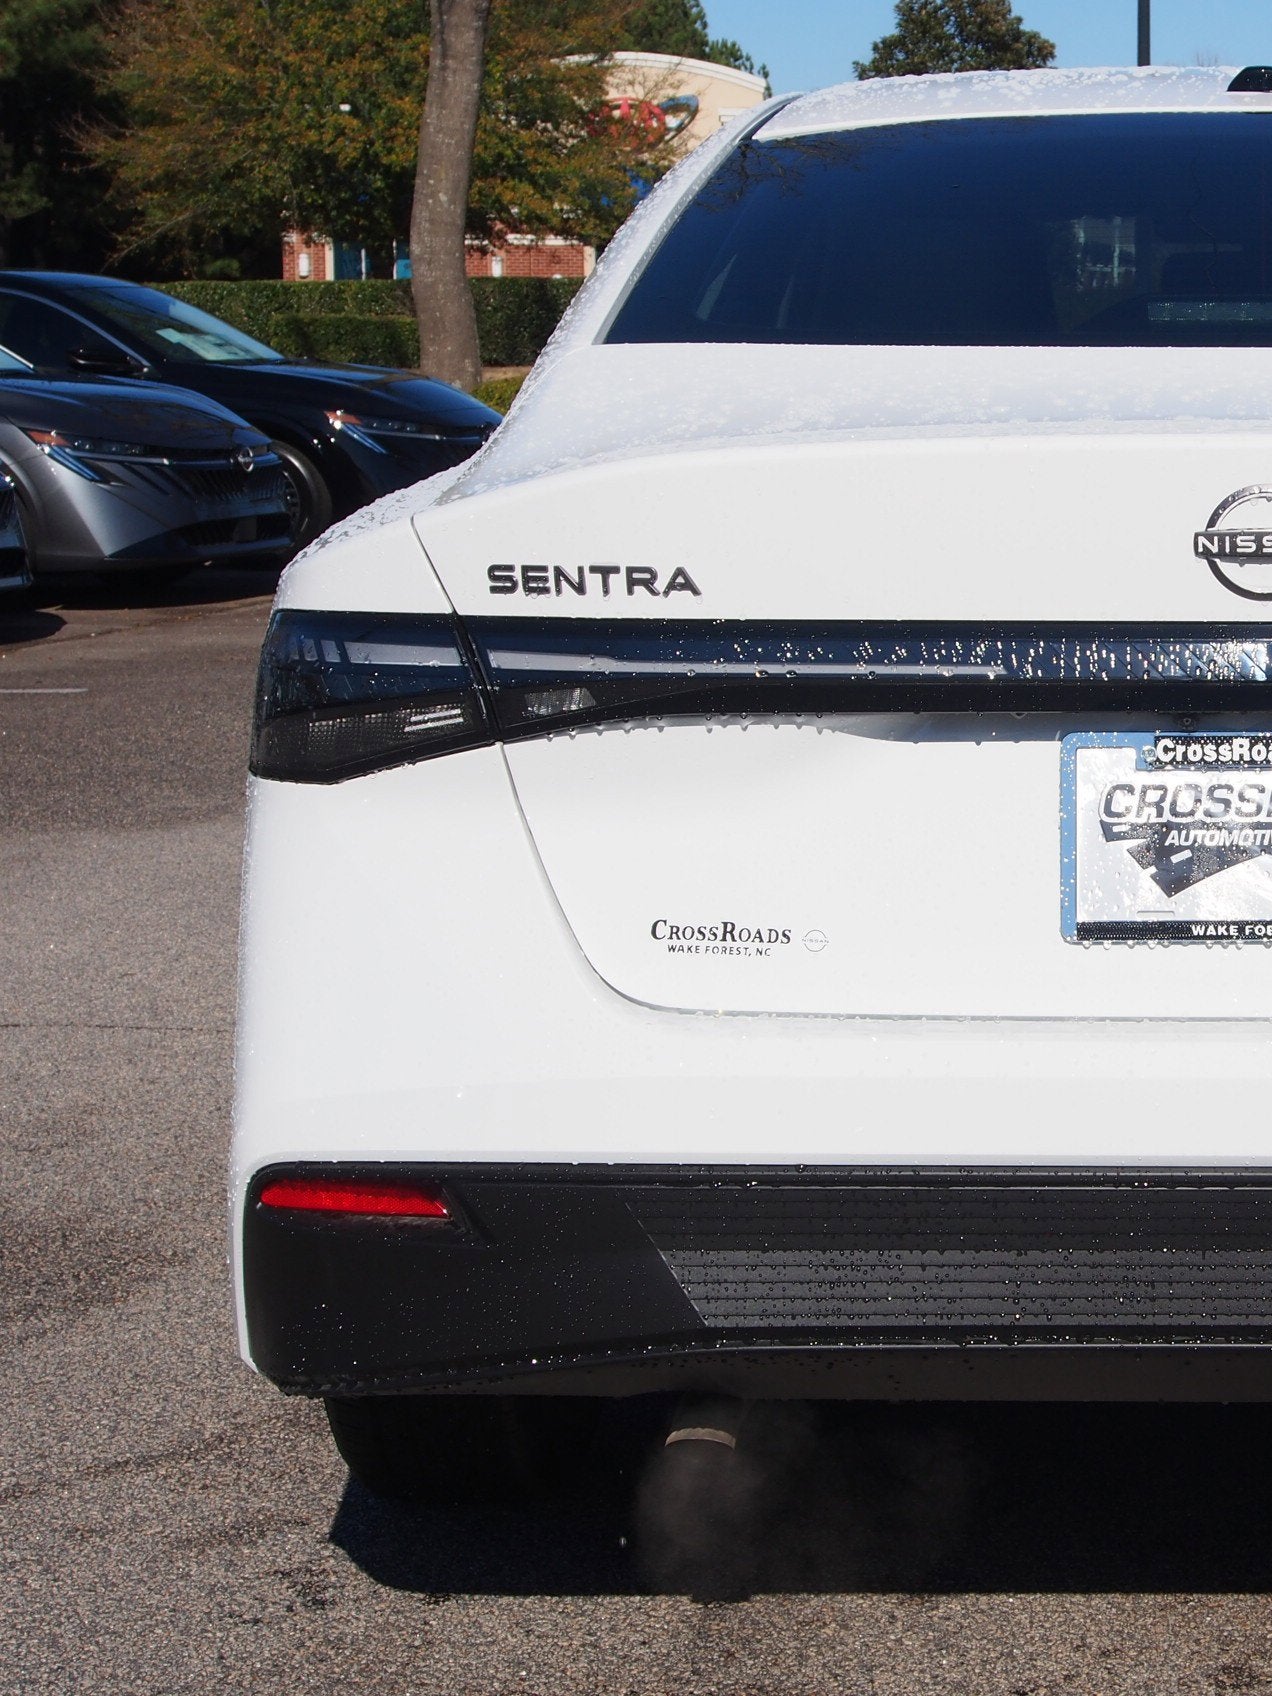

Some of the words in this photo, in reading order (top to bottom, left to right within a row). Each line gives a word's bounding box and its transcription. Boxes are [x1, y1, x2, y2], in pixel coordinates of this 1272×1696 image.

[487, 564, 702, 598] SENTRA
[1191, 924, 1239, 937] WAKE
[667, 944, 701, 954] WAKE
[704, 945, 752, 957] FOREST,
[755, 947, 771, 957] NC
